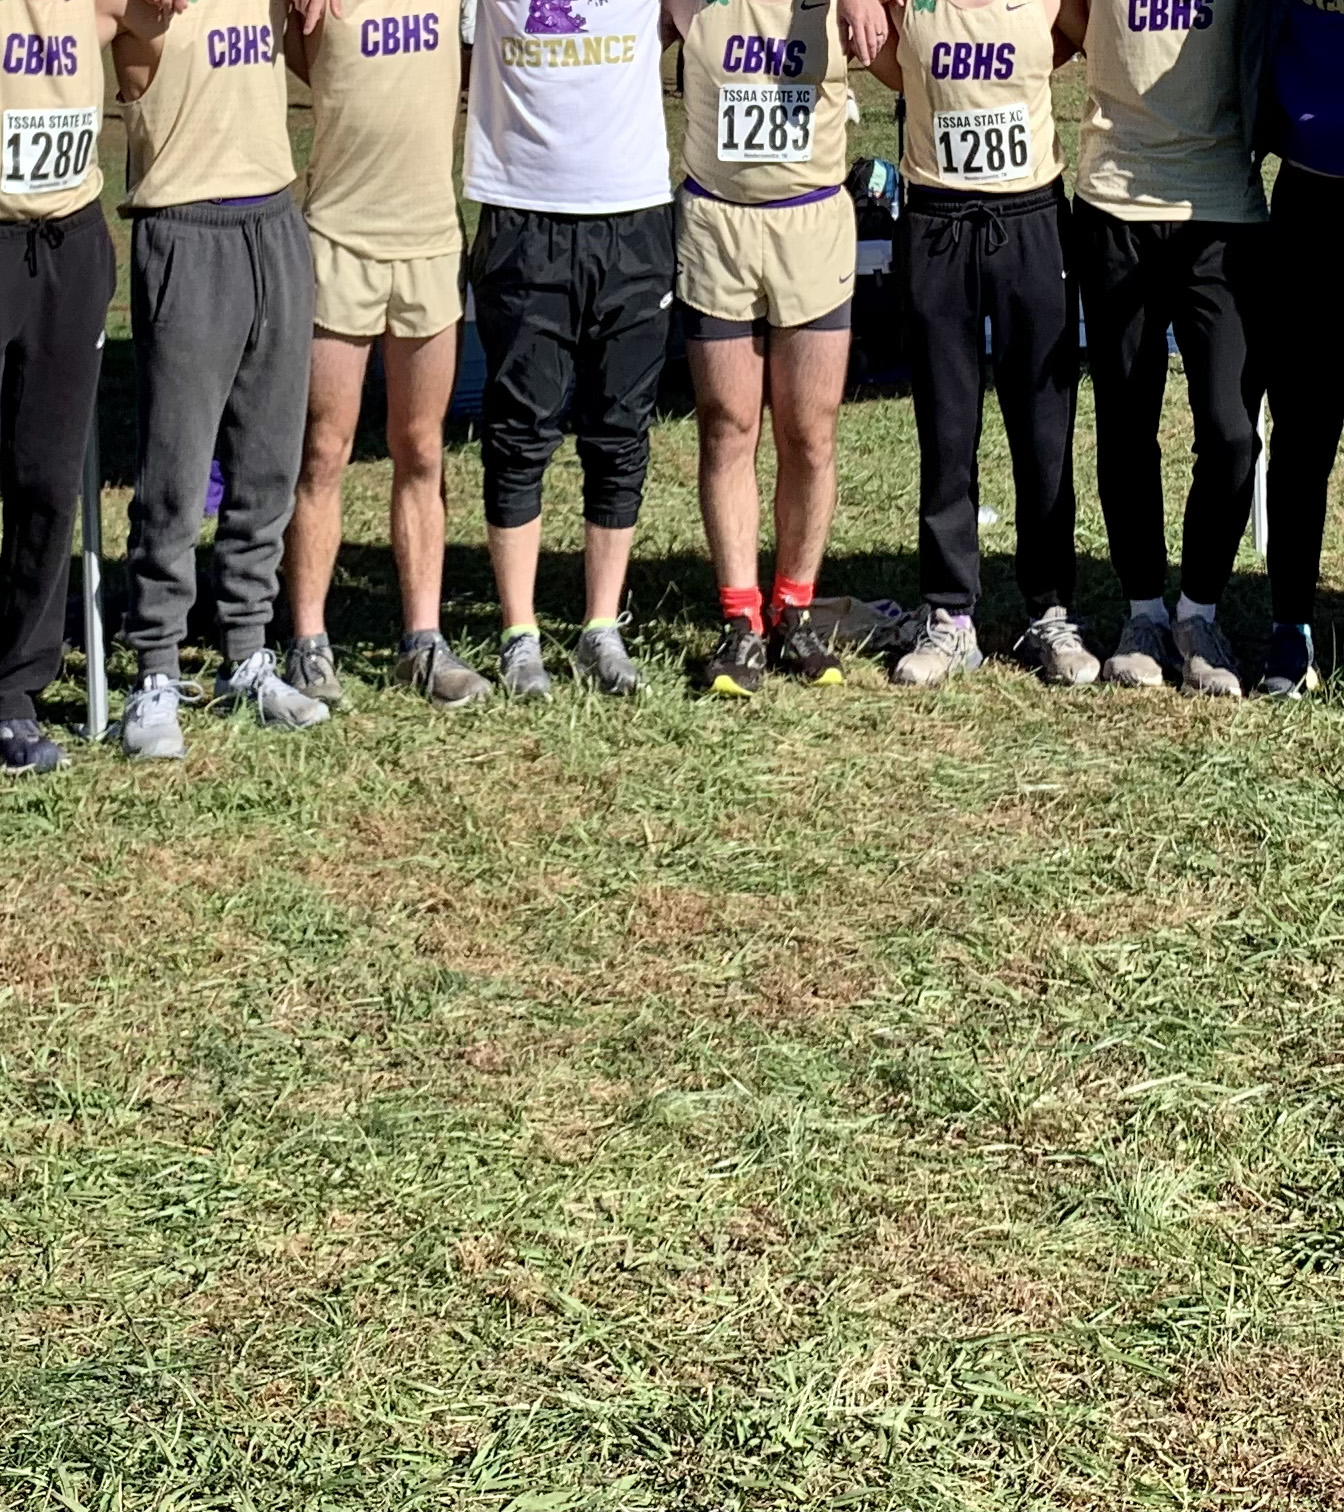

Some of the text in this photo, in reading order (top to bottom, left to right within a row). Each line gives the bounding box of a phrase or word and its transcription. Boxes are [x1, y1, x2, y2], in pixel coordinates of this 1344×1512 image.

[3, 32, 78, 77] CBHS
[206, 24, 274, 69] CBHS
[360, 12, 439, 58] CBHS
[501, 35, 637, 68] DISTANCE
[722, 34, 807, 78] CBHS
[931, 42, 1016, 81] CBHS
[723, 90, 810, 103] TSSAA STATE XC
[938, 109, 1023, 128] TSSAA STATE XC
[8, 112, 93, 129] TSSAA STATE XC
[722, 104, 810, 151] 1283
[6, 129, 93, 181] 1280
[939, 124, 1027, 173] 1286
